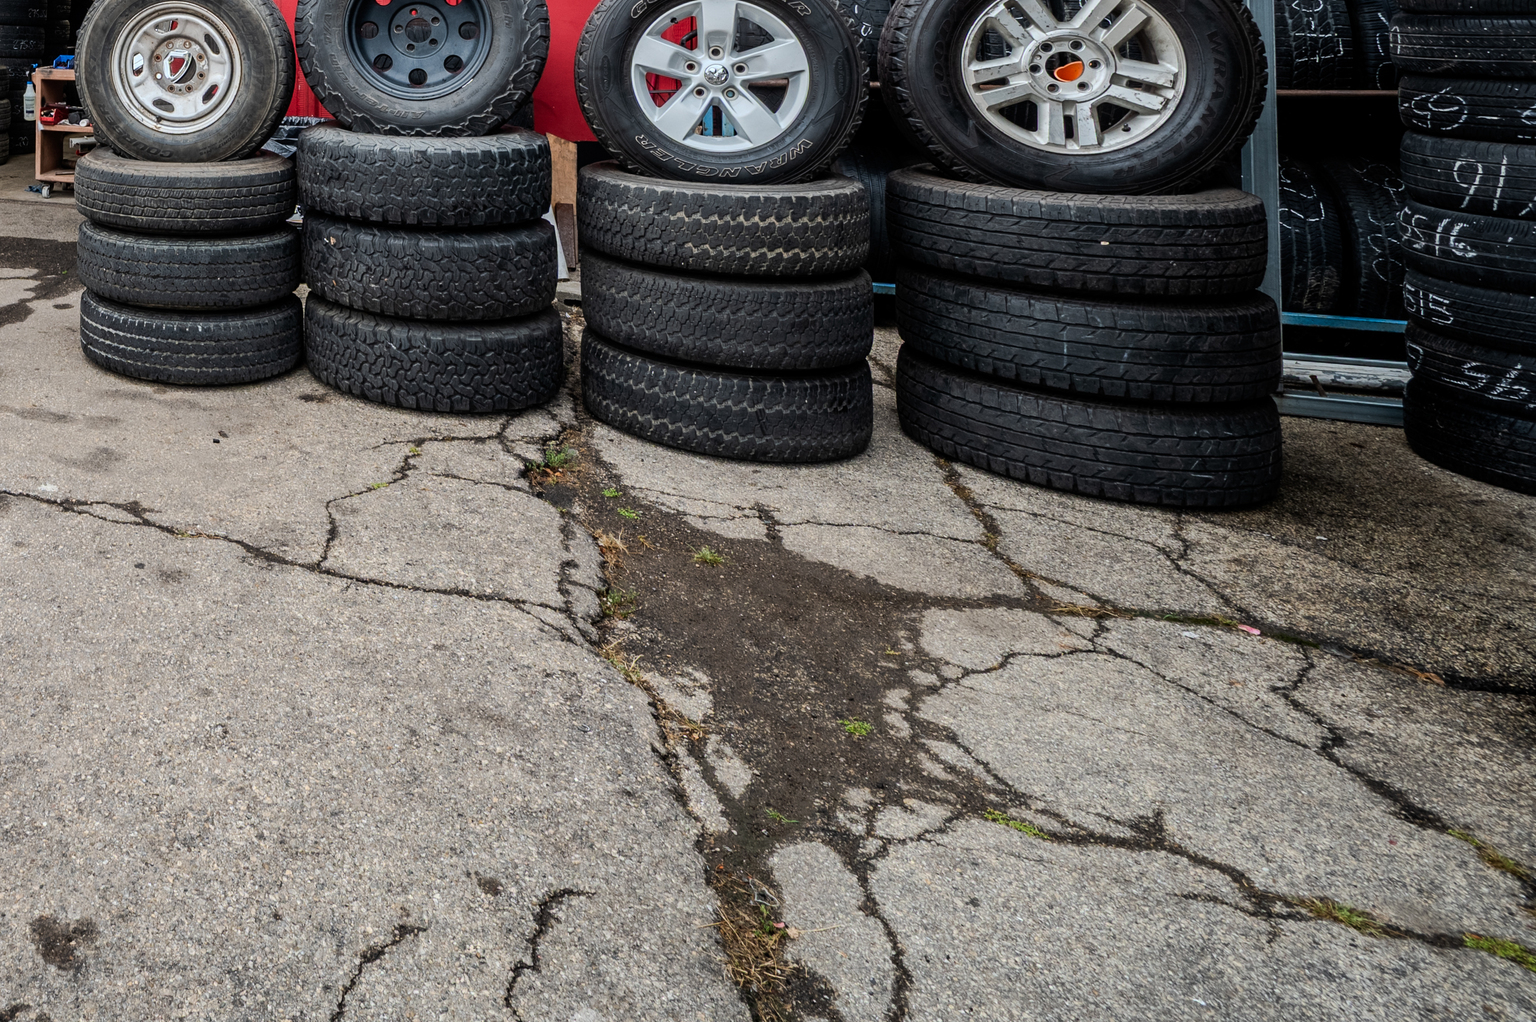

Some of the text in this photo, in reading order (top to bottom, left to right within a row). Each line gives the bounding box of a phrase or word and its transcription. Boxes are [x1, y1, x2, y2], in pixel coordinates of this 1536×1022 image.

[97, 104, 175, 159] COURSER
[1112, 28, 1228, 182] WRANGLER
[634, 133, 814, 179] WRANGLER
